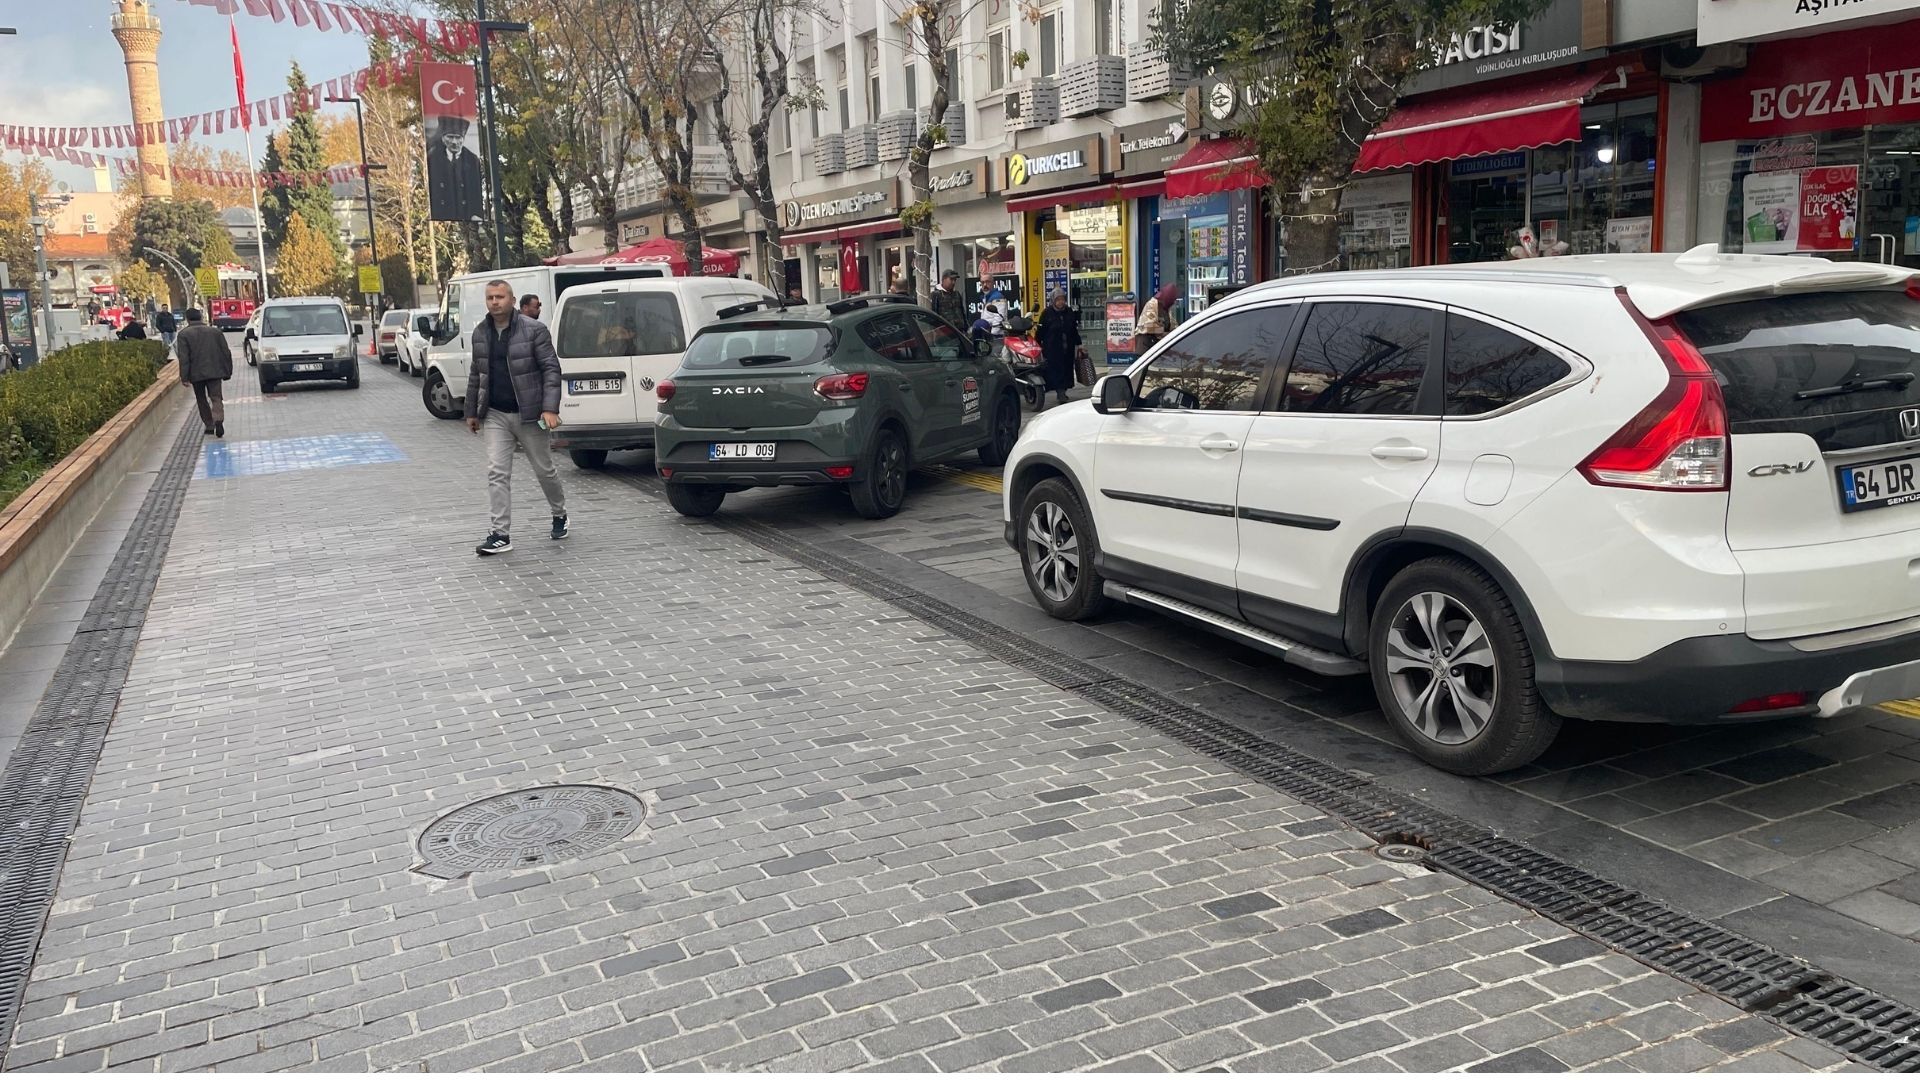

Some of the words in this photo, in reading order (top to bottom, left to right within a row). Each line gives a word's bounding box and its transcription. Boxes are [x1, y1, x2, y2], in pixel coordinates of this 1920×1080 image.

[1522, 46, 1578, 66] KURULUŞUDUR
[1749, 67, 1920, 123] ECZANE
[1136, 134, 1173, 151] Telekom
[1025, 150, 1083, 176] TURKCELL
[800, 202, 821, 221] ÖZEN
[1804, 201, 1828, 219] İLAÇ
[1237, 204, 1247, 241] Türk
[574, 381, 584, 391] 64
[605, 379, 620, 389] 515
[711, 386, 765, 395] DACIA
[715, 444, 727, 457] 64
[735, 445, 748, 457] LD
[755, 444, 774, 457] 009
[1747, 459, 1816, 477] CR-V
[1853, 469, 1881, 501] 64
[1884, 463, 1916, 495] DR
